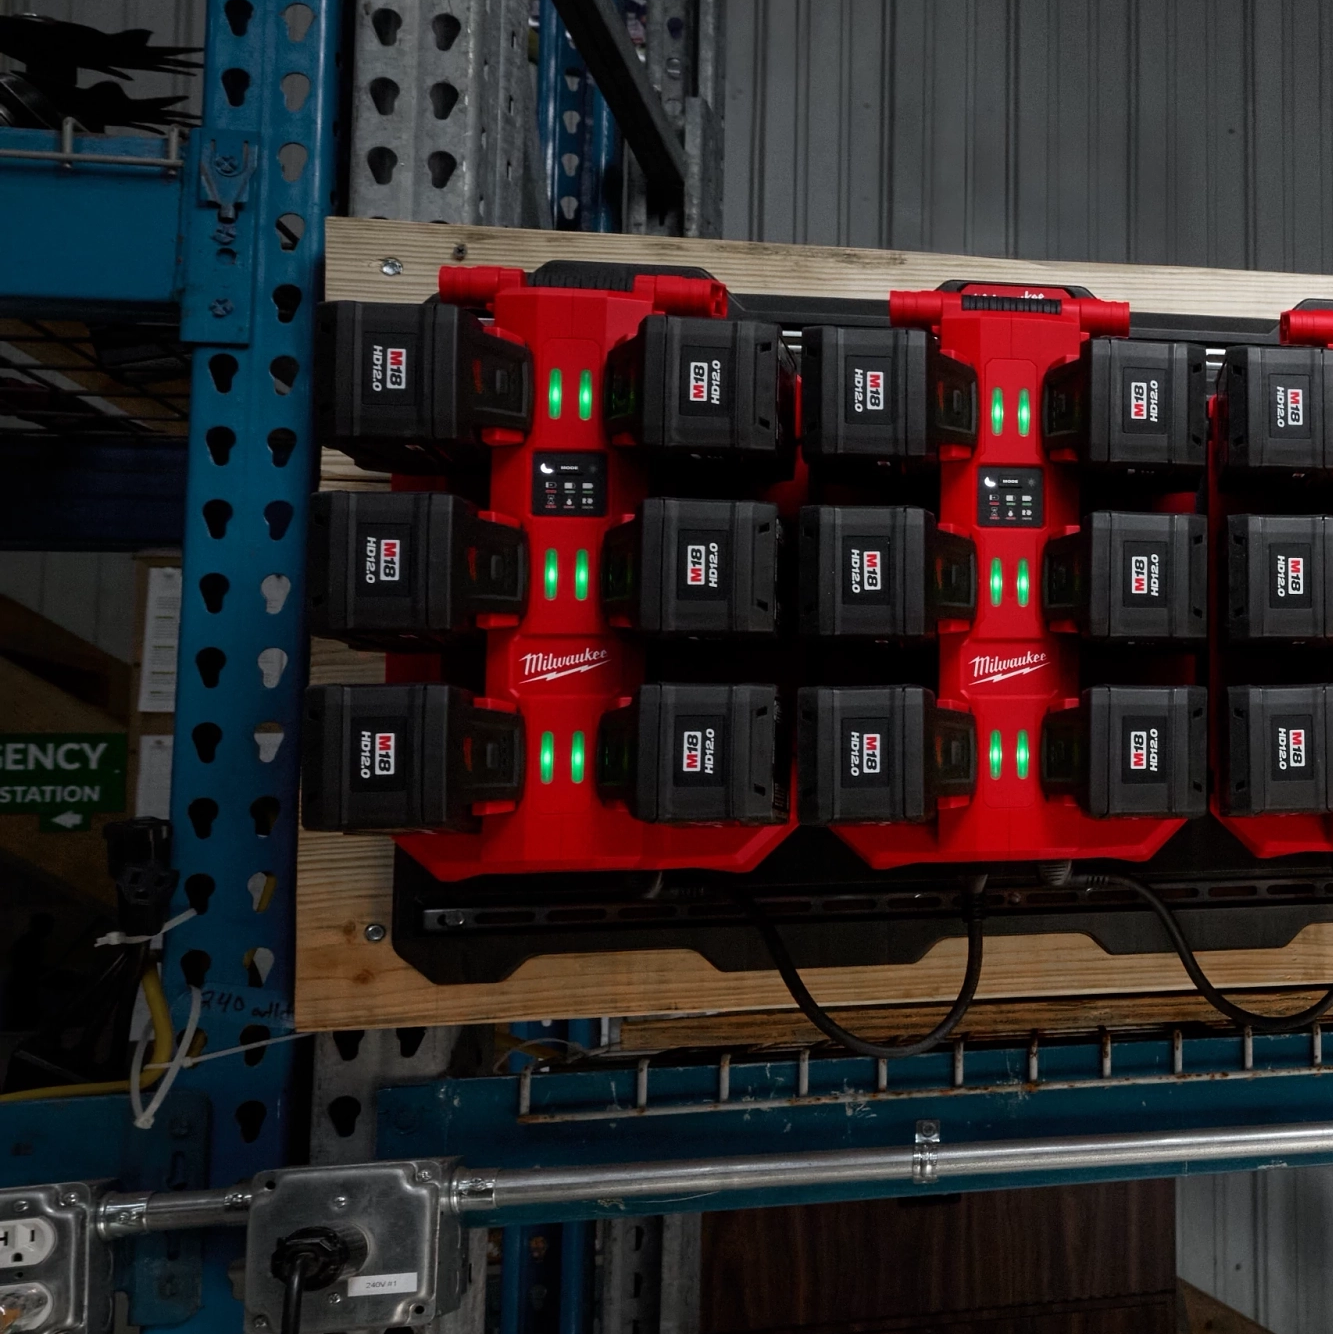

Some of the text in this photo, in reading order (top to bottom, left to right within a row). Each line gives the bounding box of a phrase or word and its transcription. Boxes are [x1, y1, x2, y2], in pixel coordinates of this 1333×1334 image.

[372, 345, 383, 392] HD12.0
[389, 350, 404, 387] M18
[692, 364, 706, 399] M18
[710, 359, 721, 405] HD12.0
[854, 368, 864, 413] HD12.0
[869, 373, 882, 408] M18
[1133, 384, 1145, 417] M18
[1149, 379, 1159, 423] HD12.0
[1276, 385, 1286, 428] HD12.0
[1289, 391, 1301, 423] M18
[365, 536, 377, 584] HD12.0
[382, 542, 398, 578] M18
[689, 548, 703, 583] M18
[708, 542, 719, 588] HD12.0
[850, 548, 861, 594] HD12.0
[866, 553, 879, 588] M18
[1133, 557, 1146, 593] M18
[1150, 553, 1160, 597] HD12.0
[1277, 554, 1286, 598] HD12.0
[1289, 559, 1302, 593] M18
[519, 648, 607, 676] Milwaukee
[968, 651, 1047, 677] Milwaukee
[0, 742, 108, 770] ENCY
[360, 730, 372, 779] HD12.0
[377, 735, 393, 772] M18
[685, 734, 699, 769] M18
[704, 728, 715, 774] HD12.0
[850, 731, 860, 777] HD12.0
[865, 736, 878, 771] M18
[1133, 733, 1145, 767] M18
[1149, 728, 1159, 772] HD12.0
[1278, 727, 1288, 770] HD12.0
[1291, 731, 1303, 764] M18
[0, 785, 101, 804] STATION
